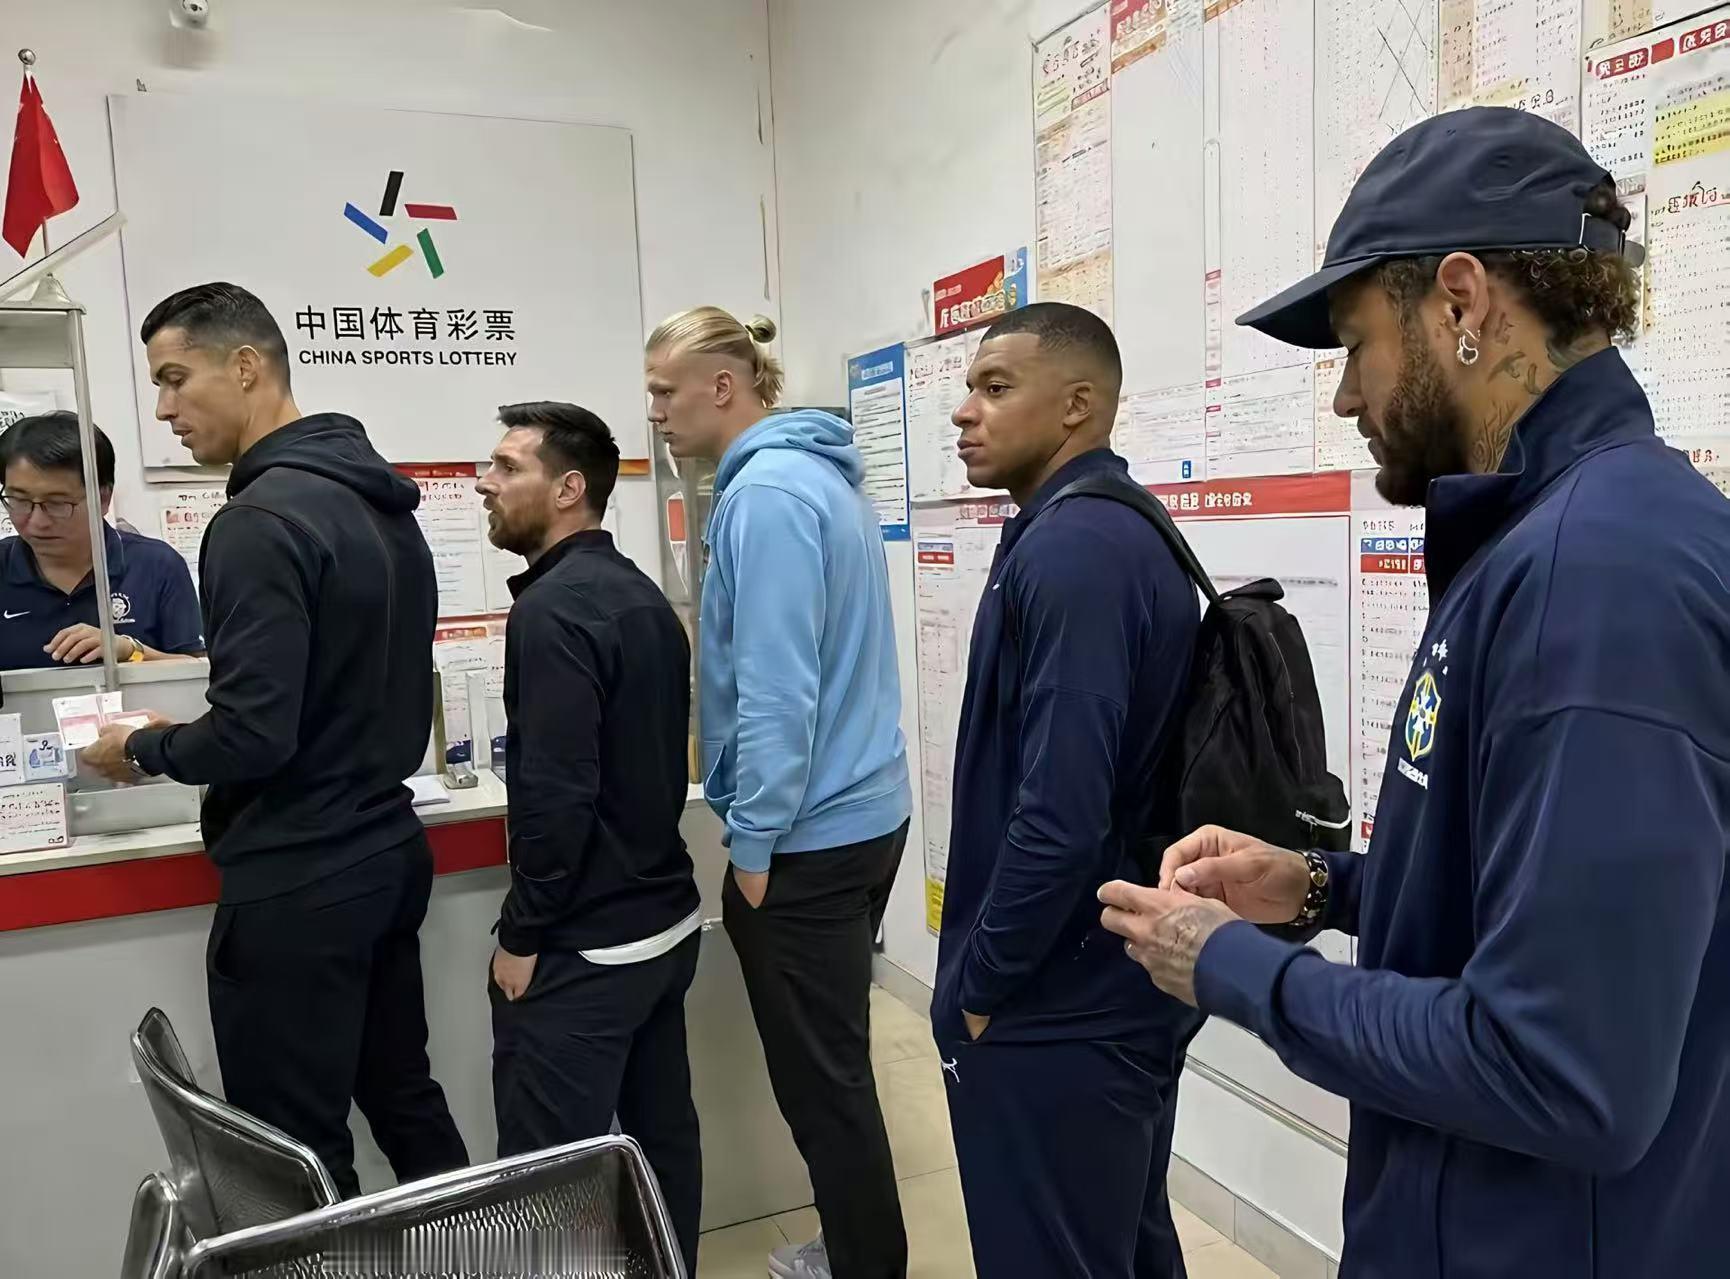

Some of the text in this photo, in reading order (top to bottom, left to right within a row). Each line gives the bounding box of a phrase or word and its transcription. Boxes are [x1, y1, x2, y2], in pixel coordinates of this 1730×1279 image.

[296, 305, 515, 341] 中国体育彩票
[299, 350, 517, 366] CHINA SPORTS LOTTERY
